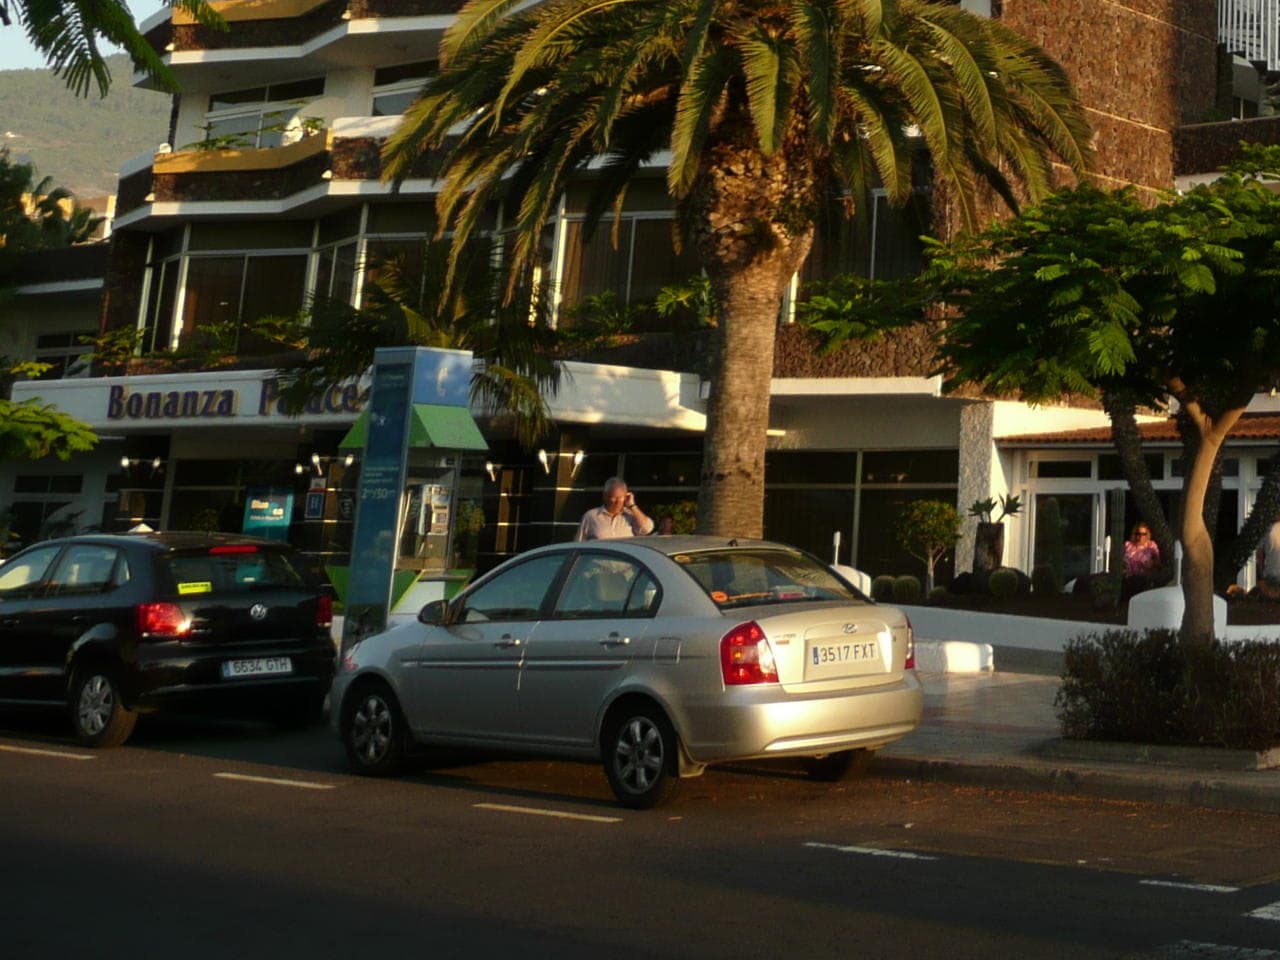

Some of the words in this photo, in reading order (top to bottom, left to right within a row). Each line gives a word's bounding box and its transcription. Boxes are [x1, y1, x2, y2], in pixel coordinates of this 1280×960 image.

[107, 384, 237, 419] Bonanza
[258, 377, 362, 417] Paace
[820, 644, 850, 662] 3517
[853, 642, 875, 660] FXT
